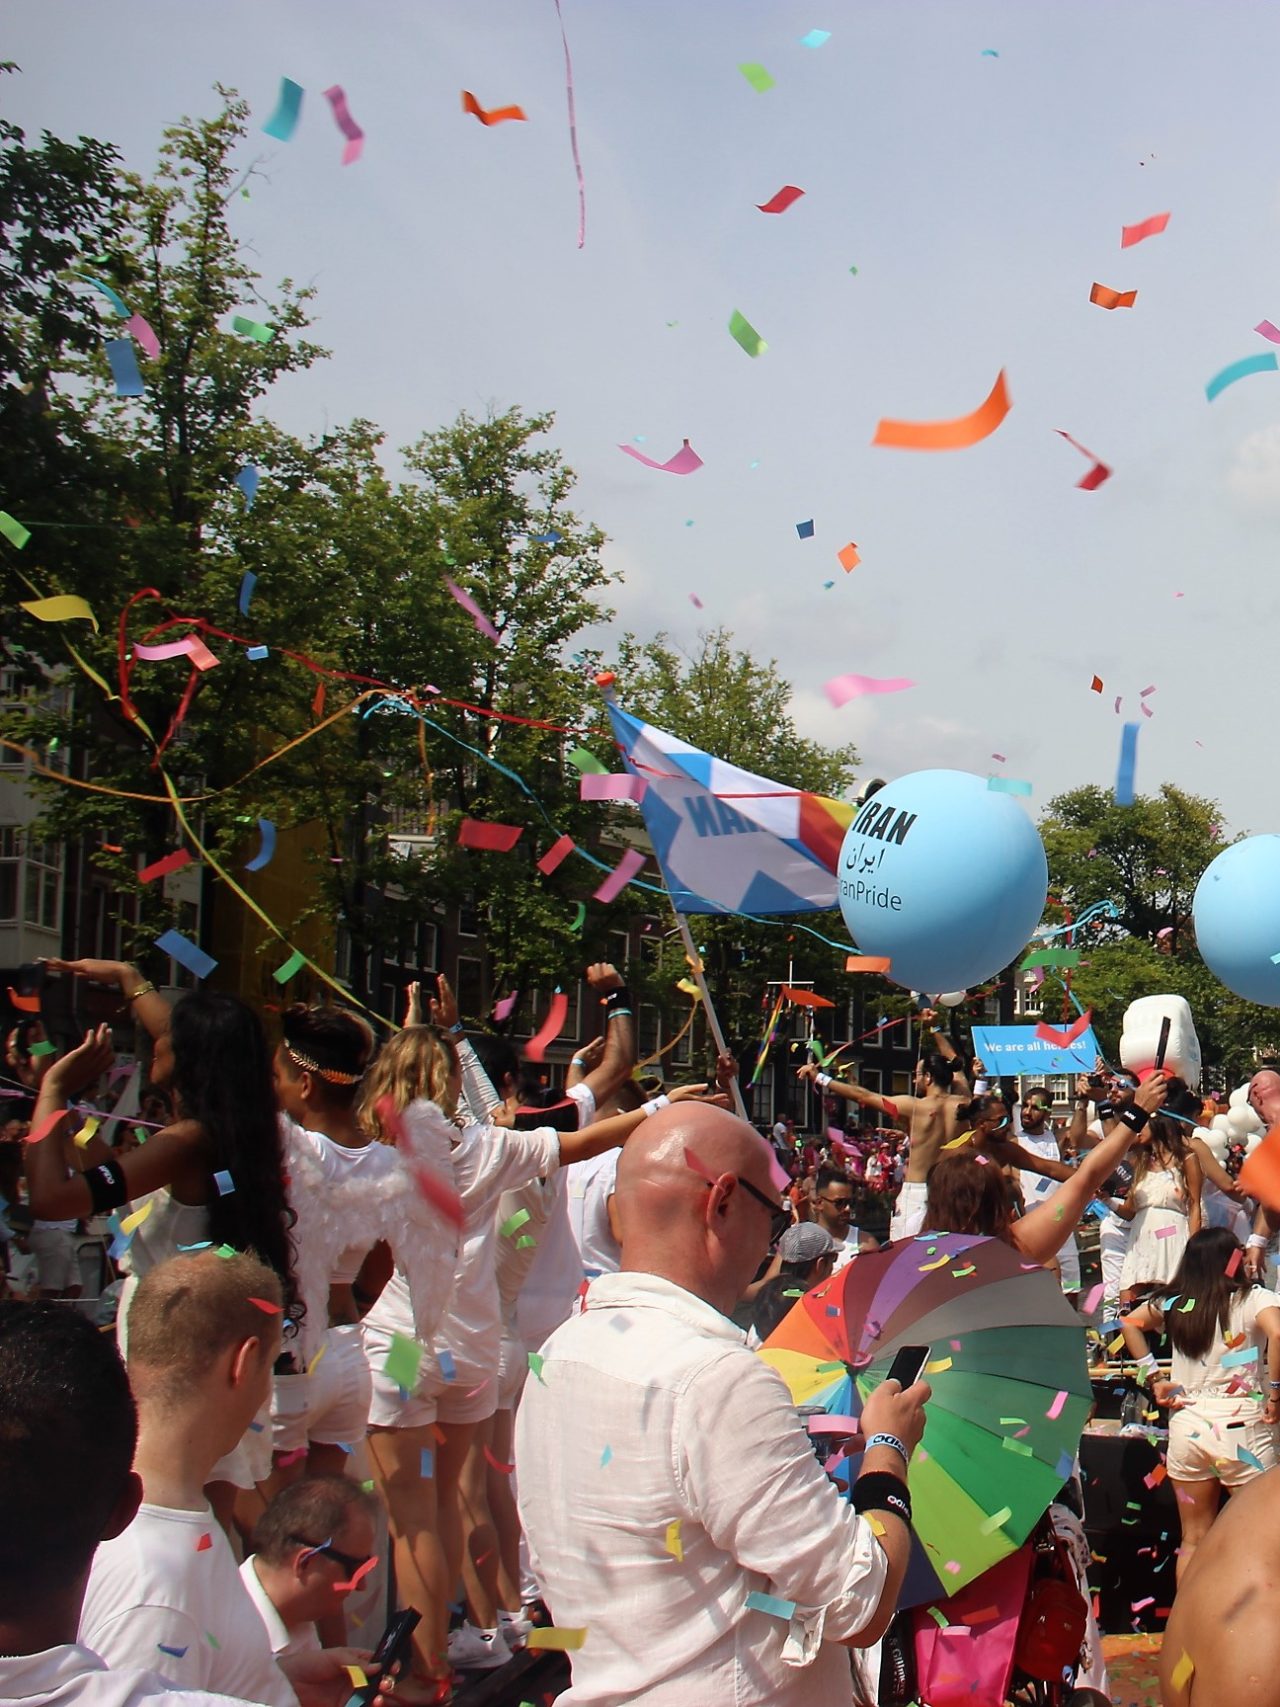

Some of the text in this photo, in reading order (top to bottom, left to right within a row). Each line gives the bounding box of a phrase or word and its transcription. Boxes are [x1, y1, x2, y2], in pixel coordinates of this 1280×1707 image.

[852, 801, 918, 845] IRAN
[846, 842, 885, 874] ایران
[984, 1041, 1087, 1052] We are all hees!
